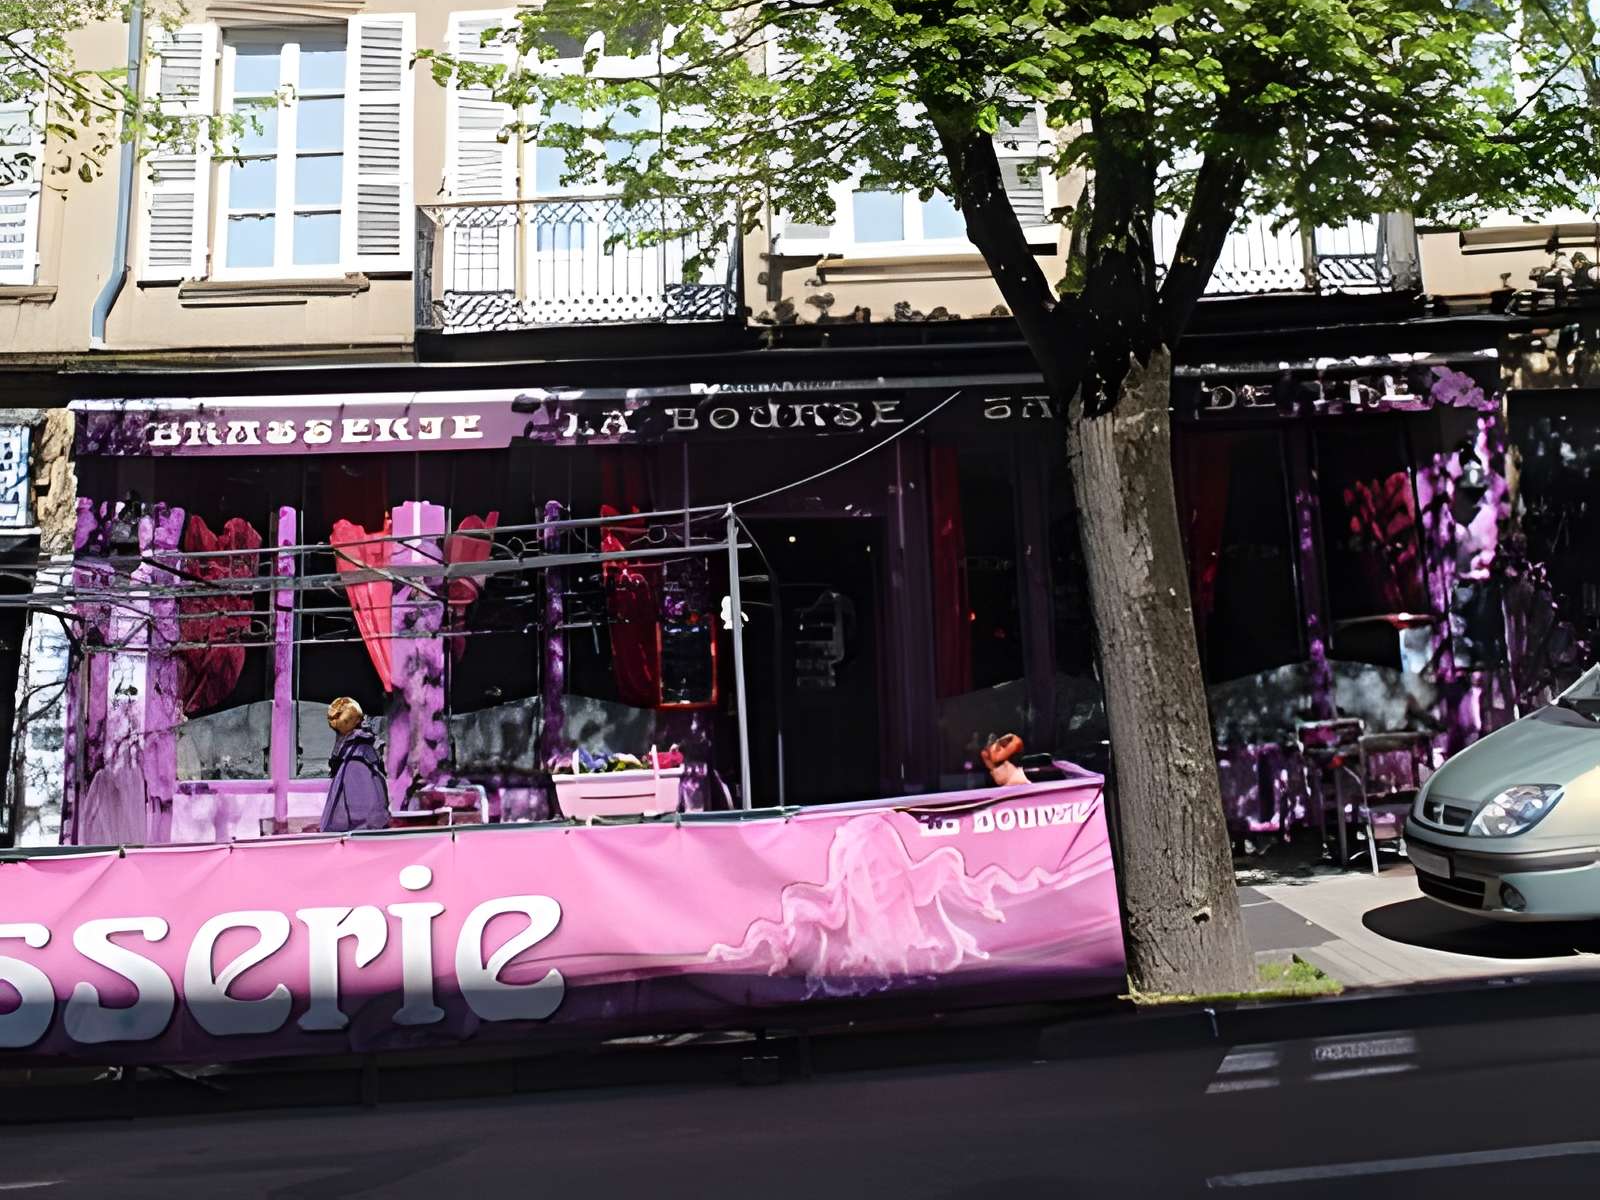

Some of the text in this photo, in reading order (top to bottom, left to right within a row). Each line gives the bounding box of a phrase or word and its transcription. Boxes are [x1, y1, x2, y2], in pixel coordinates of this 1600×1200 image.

[148, 398, 905, 446] BRASSERIE LA BOURSE
